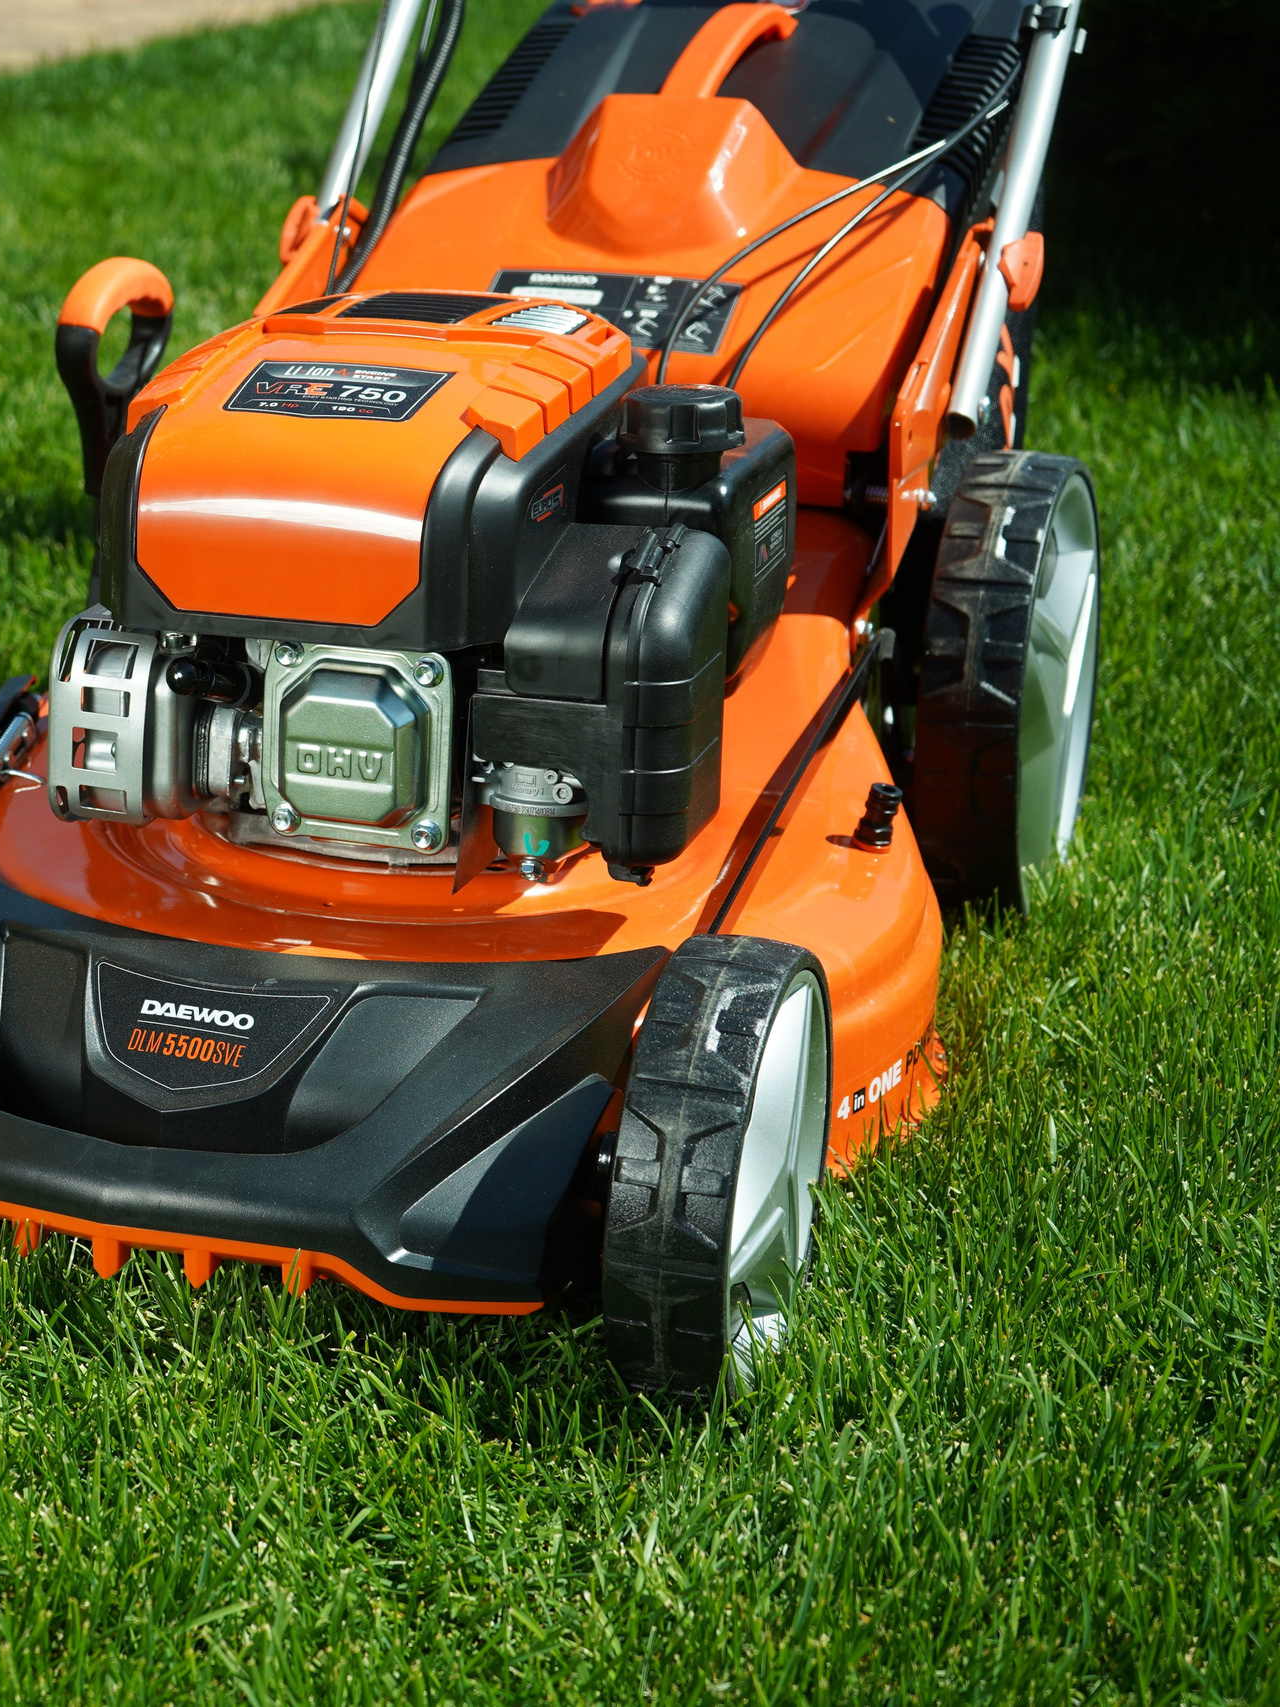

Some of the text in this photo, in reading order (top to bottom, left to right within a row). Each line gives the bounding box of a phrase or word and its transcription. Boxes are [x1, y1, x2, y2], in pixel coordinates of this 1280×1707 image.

[352, 374, 391, 382] START
[354, 369, 398, 378] ENGINE
[339, 385, 407, 403] 750
[354, 398, 399, 407] TECHNOLOGY
[297, 744, 382, 781] OHV
[140, 999, 255, 1030] DAEWOO
[837, 1095, 850, 1120] 4
[853, 1094, 865, 1111] in
[868, 1058, 902, 1103] ONE
